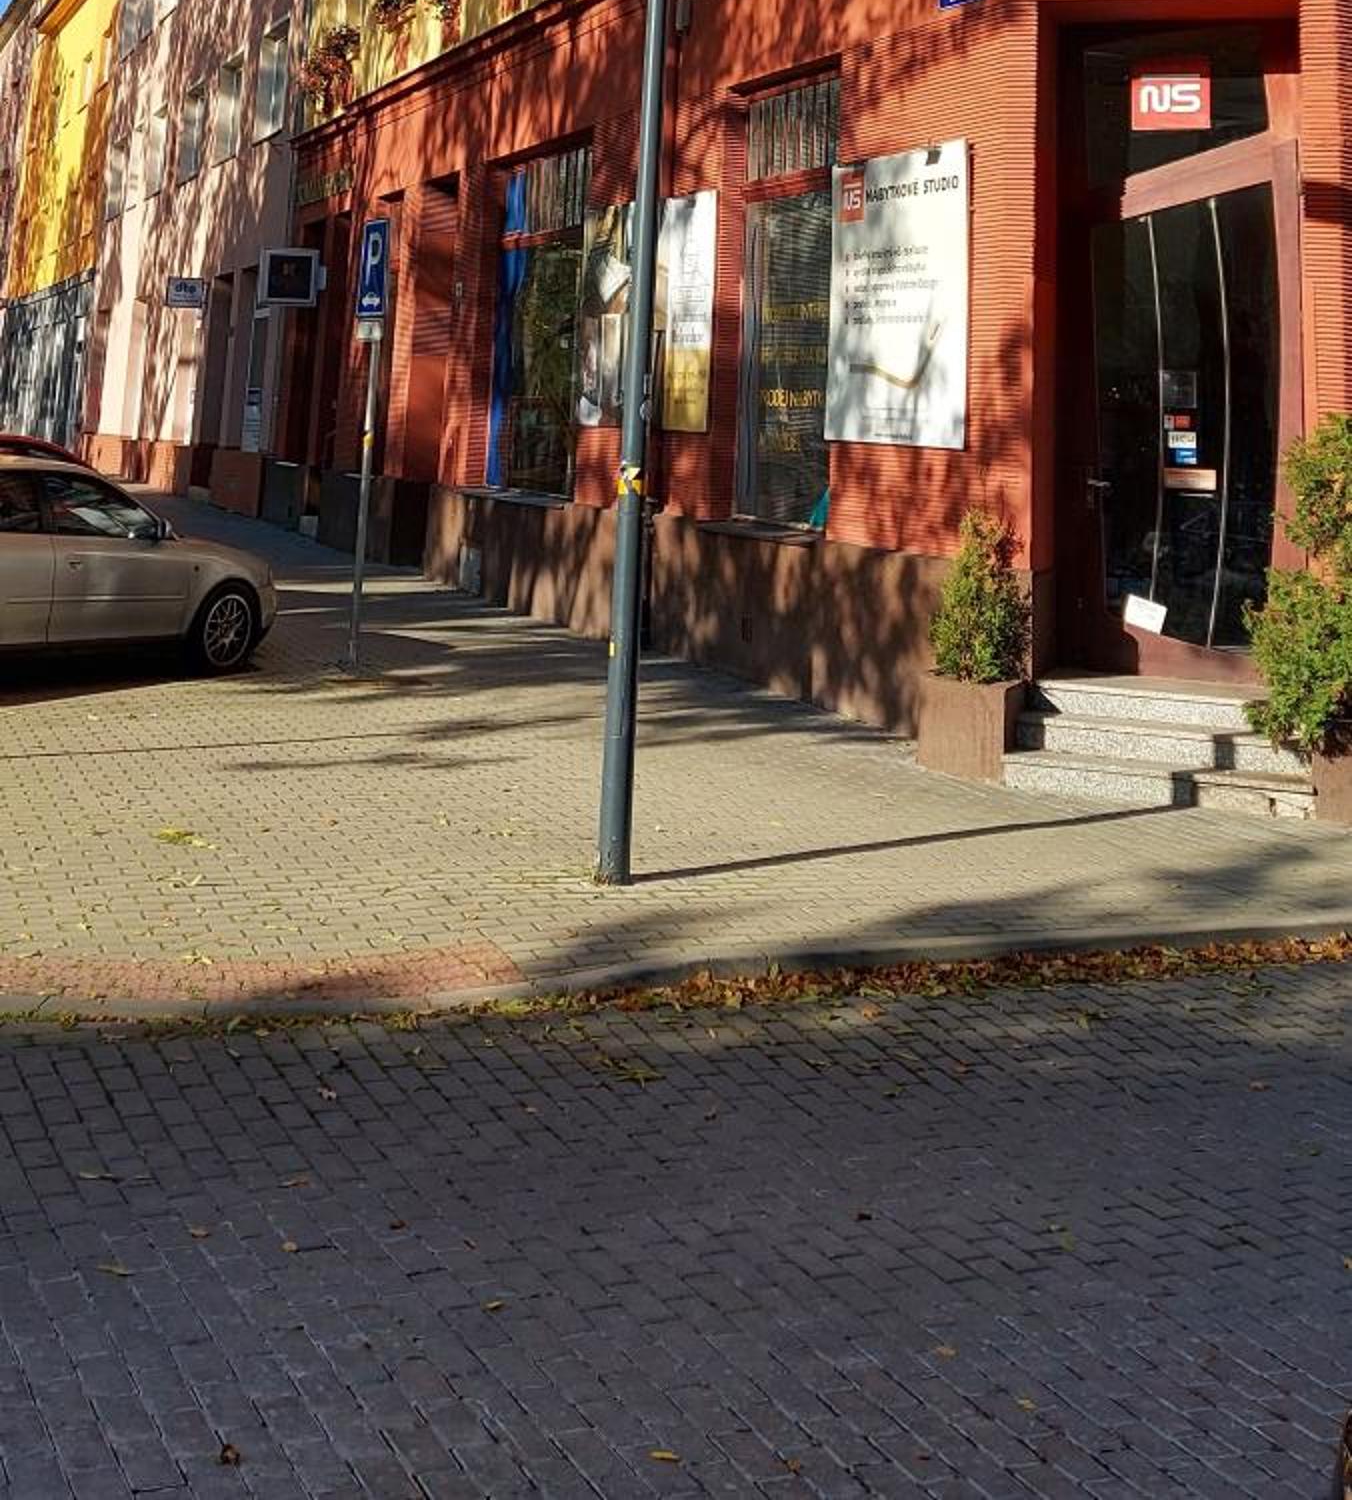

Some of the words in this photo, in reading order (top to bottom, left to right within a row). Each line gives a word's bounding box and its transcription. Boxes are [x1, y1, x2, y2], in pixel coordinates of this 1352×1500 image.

[1139, 83, 1201, 115] NS
[923, 175, 959, 196] STUDIO
[364, 231, 382, 287] P
